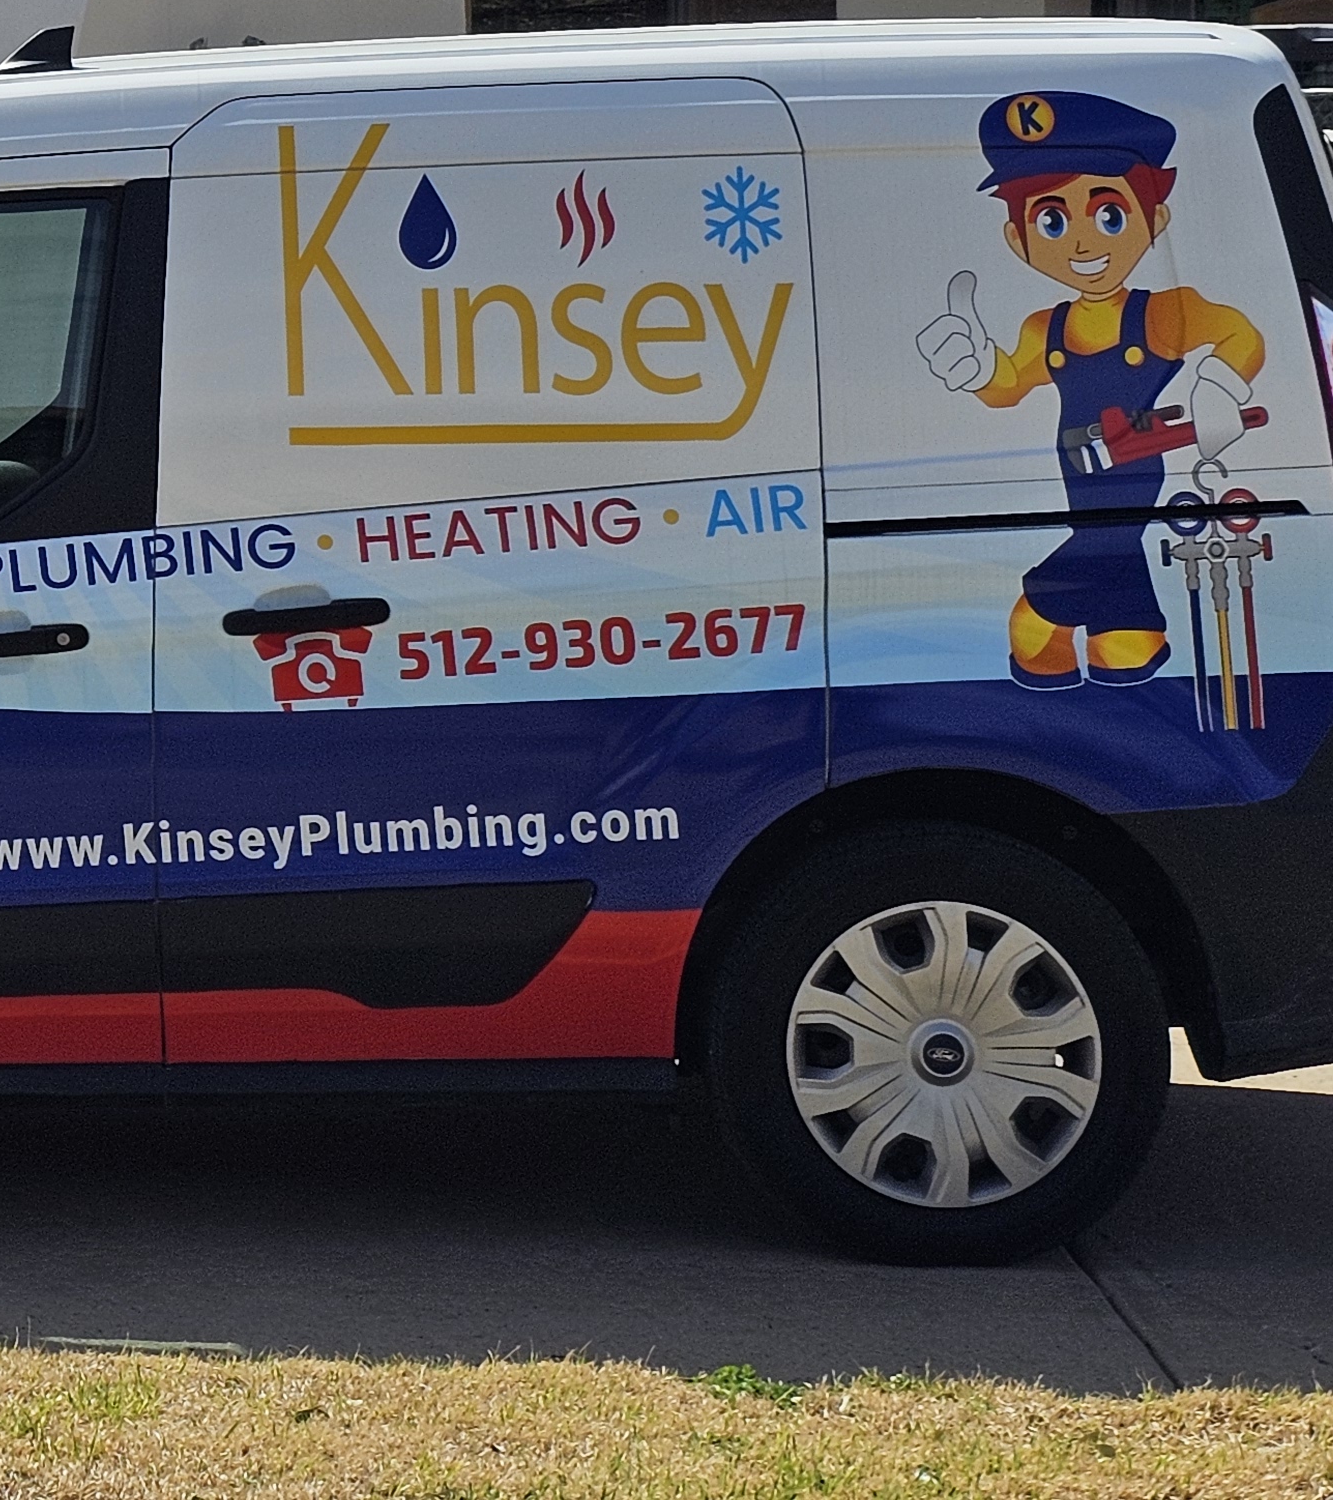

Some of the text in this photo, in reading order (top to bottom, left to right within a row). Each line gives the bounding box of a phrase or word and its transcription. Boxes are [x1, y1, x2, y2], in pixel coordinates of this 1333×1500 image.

[1017, 101, 1044, 136] K
[278, 123, 795, 446] Kinsey
[357, 497, 643, 564] HEATING
[706, 484, 808, 538] AIR
[399, 603, 807, 681] 512-930-2677
